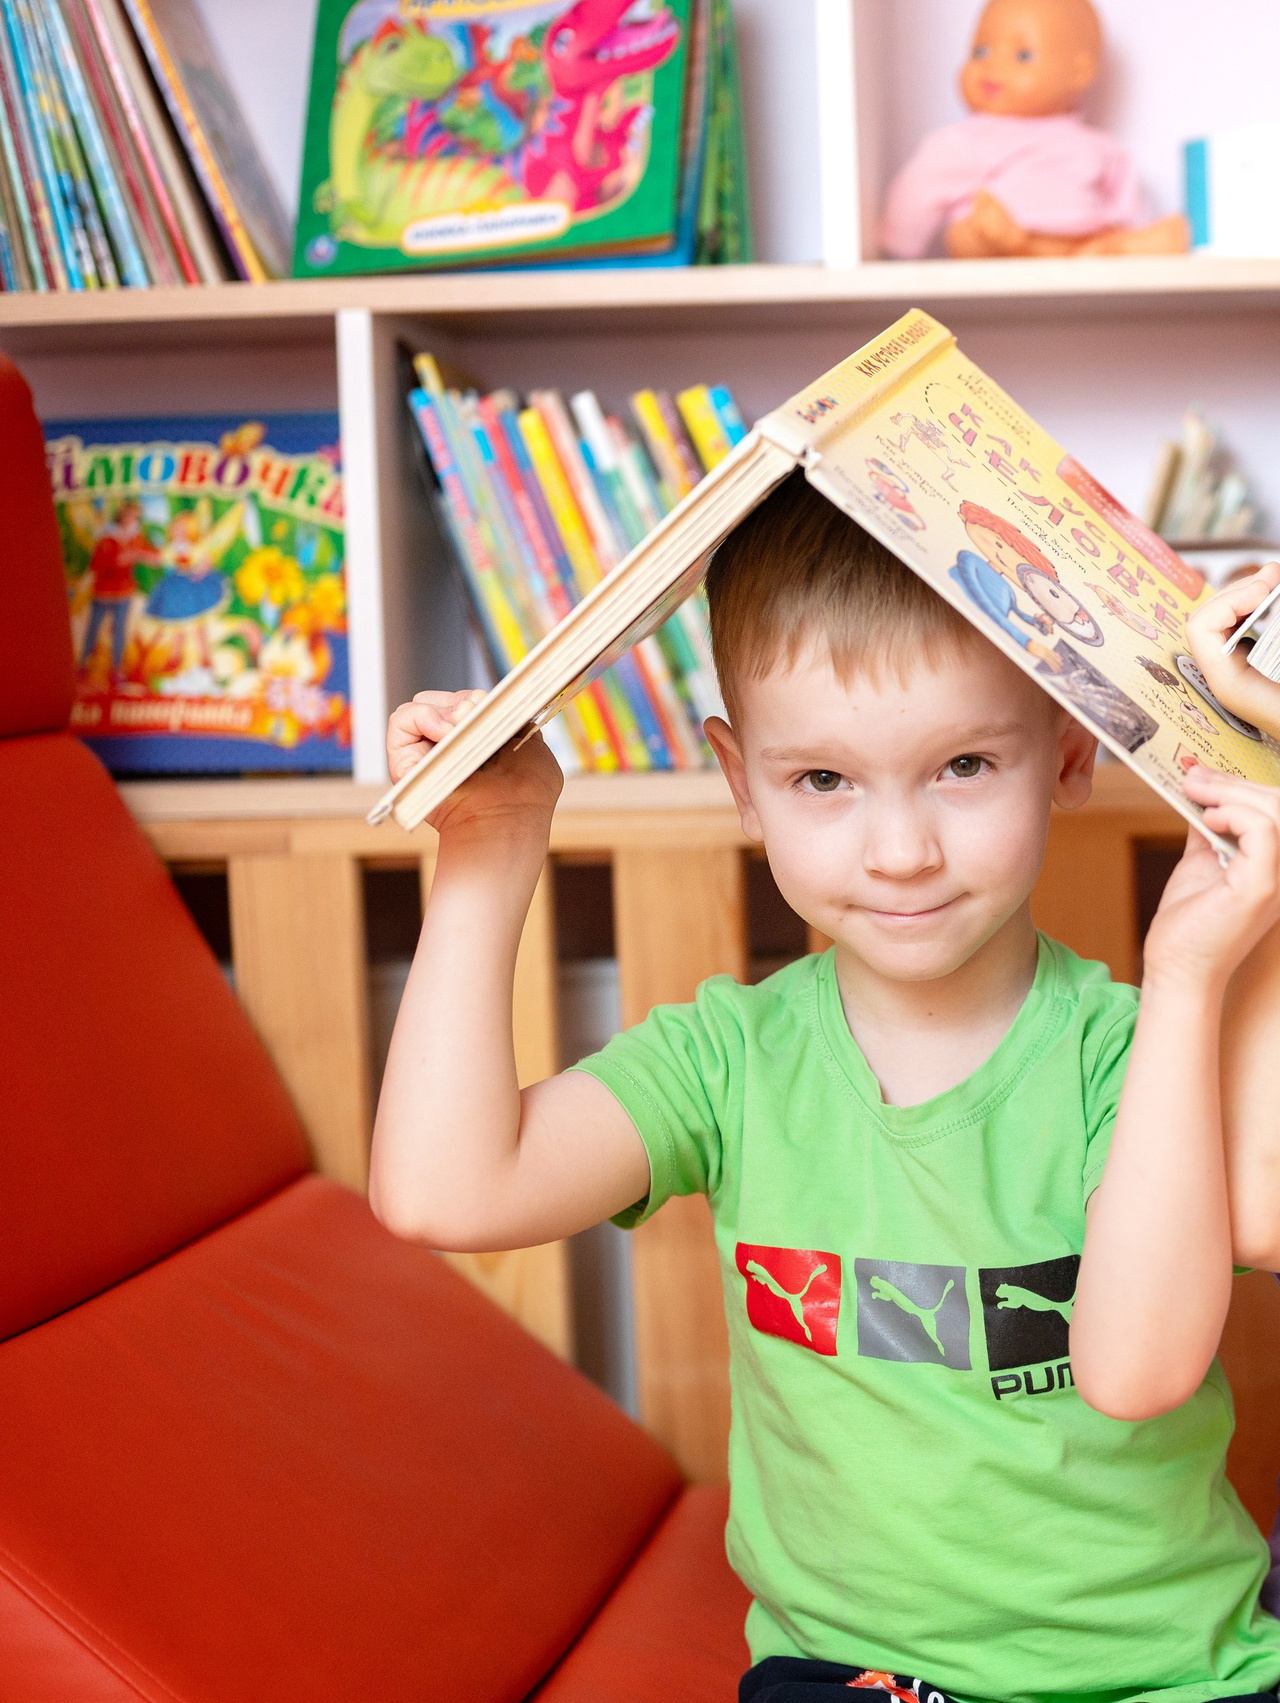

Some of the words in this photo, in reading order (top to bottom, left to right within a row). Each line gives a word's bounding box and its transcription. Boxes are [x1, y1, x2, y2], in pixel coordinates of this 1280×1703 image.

[855, 359, 881, 378] КАК
[948, 411, 1183, 640] ЧЕЛОВЕ
[960, 402, 1042, 483] КАК
[1059, 497, 1189, 623] УСТРО
[1007, 497, 1047, 537] Почему
